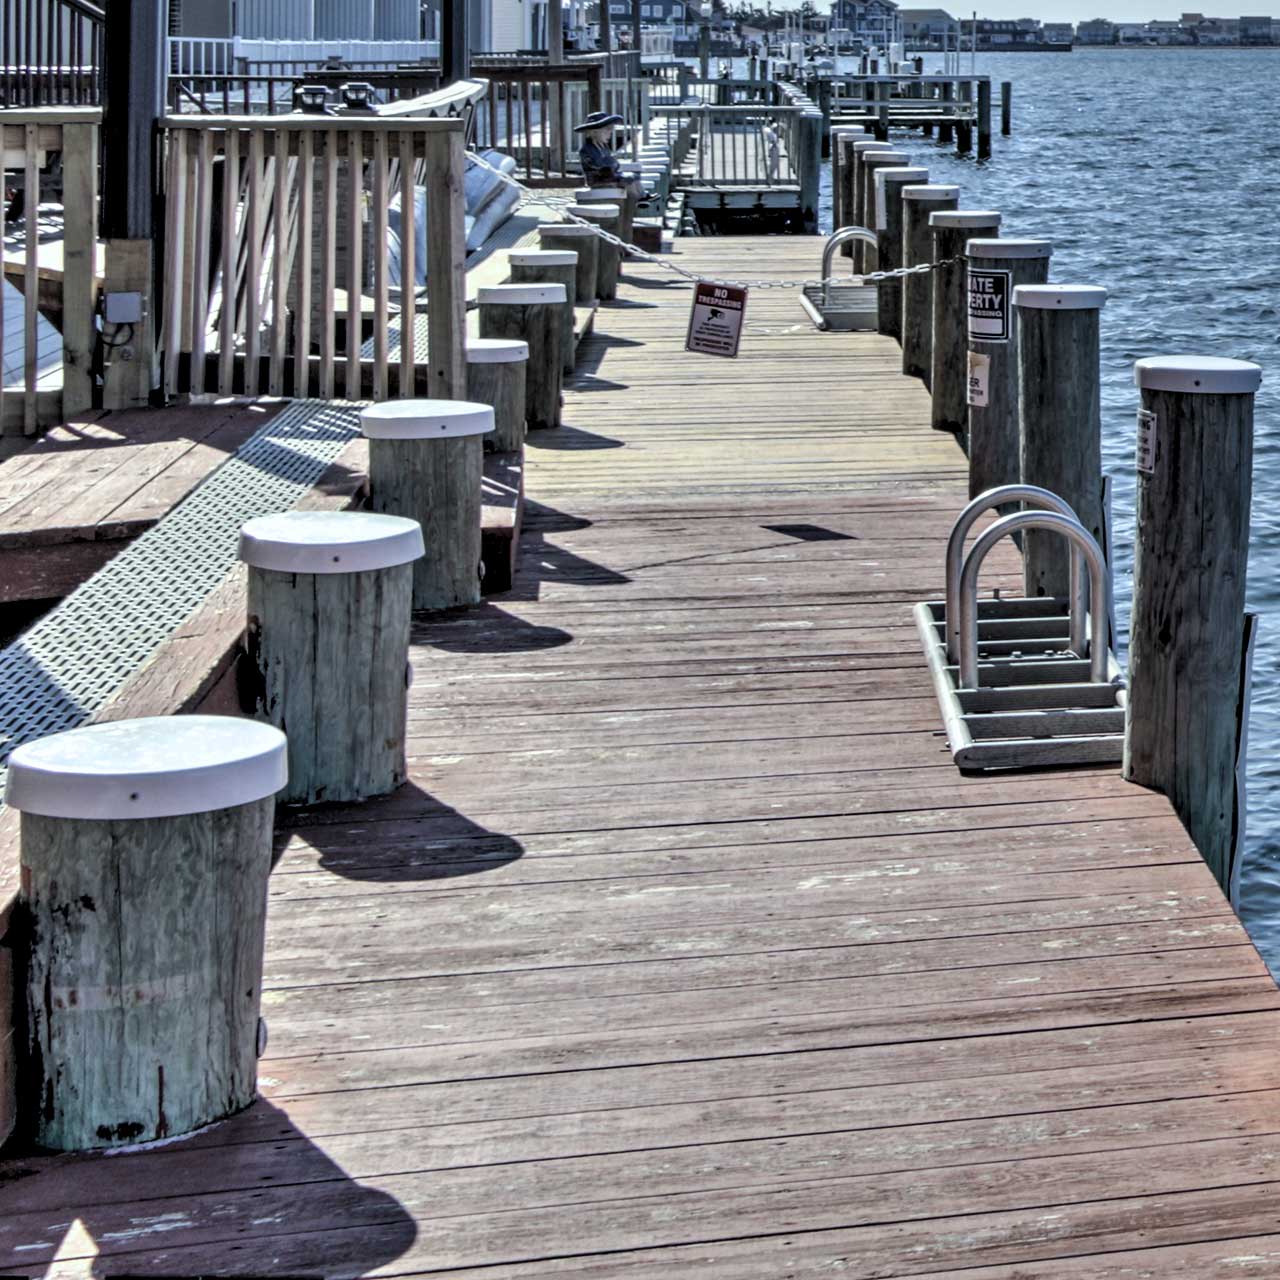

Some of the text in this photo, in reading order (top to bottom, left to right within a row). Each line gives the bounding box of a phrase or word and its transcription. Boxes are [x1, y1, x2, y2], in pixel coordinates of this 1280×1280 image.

[714, 287, 728, 299] NO
[698, 294, 742, 309] TRESPASSING
[970, 377, 980, 388] ER
